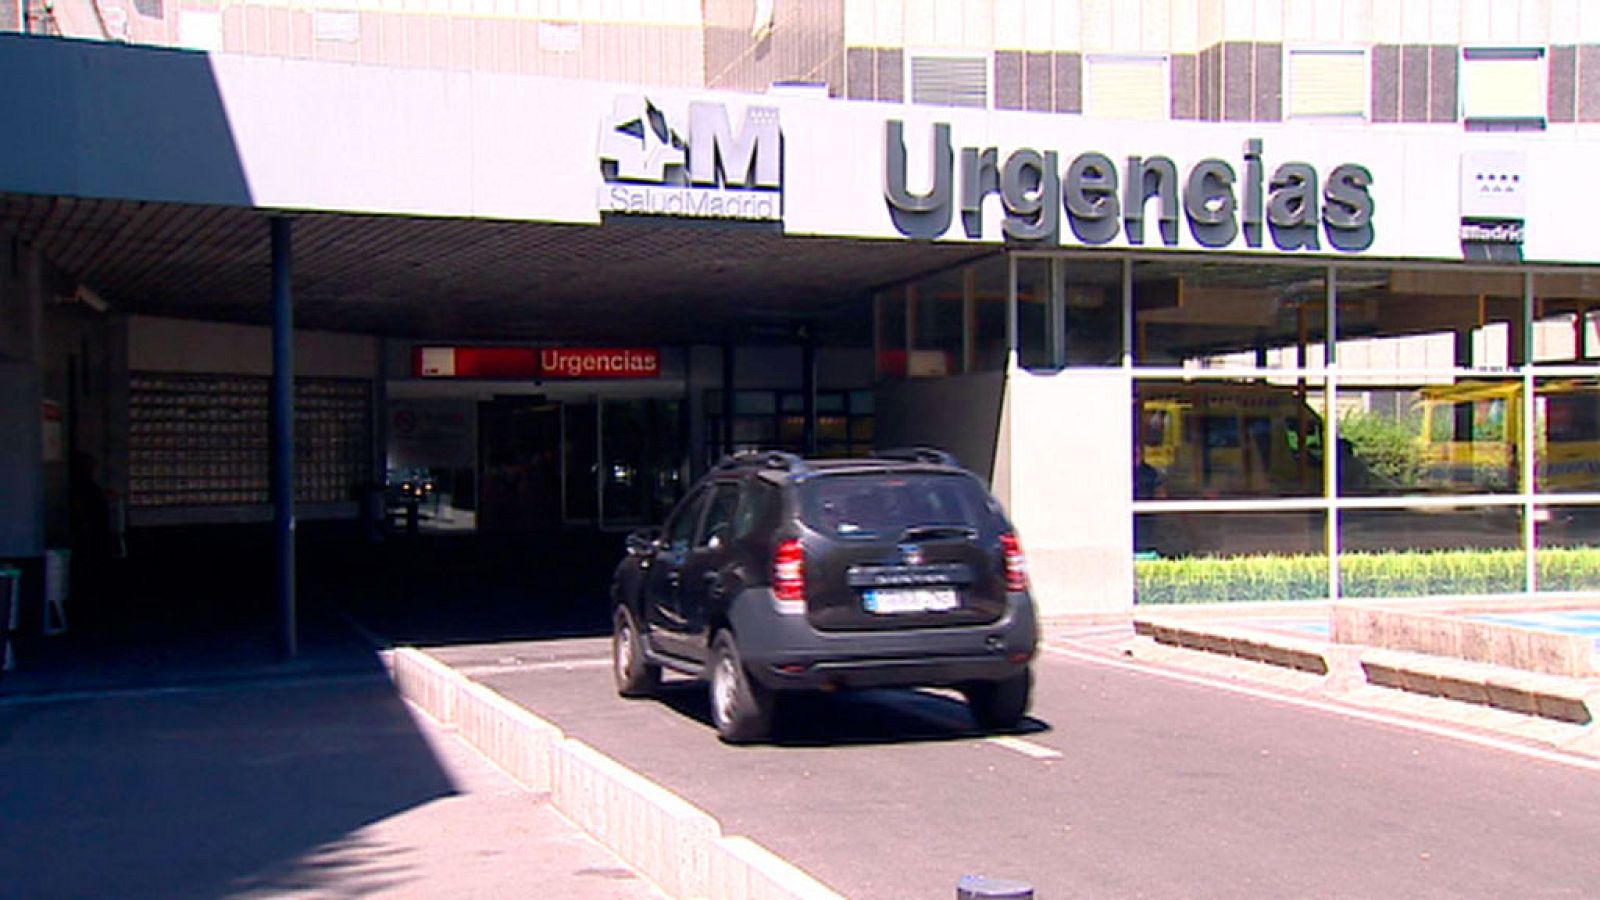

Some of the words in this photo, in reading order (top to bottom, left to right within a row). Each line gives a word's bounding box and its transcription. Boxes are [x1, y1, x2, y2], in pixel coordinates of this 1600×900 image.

[884, 119, 1375, 250] Urgencias
[610, 187, 773, 218] SaludMadrid
[540, 349, 657, 375] Urgencias
